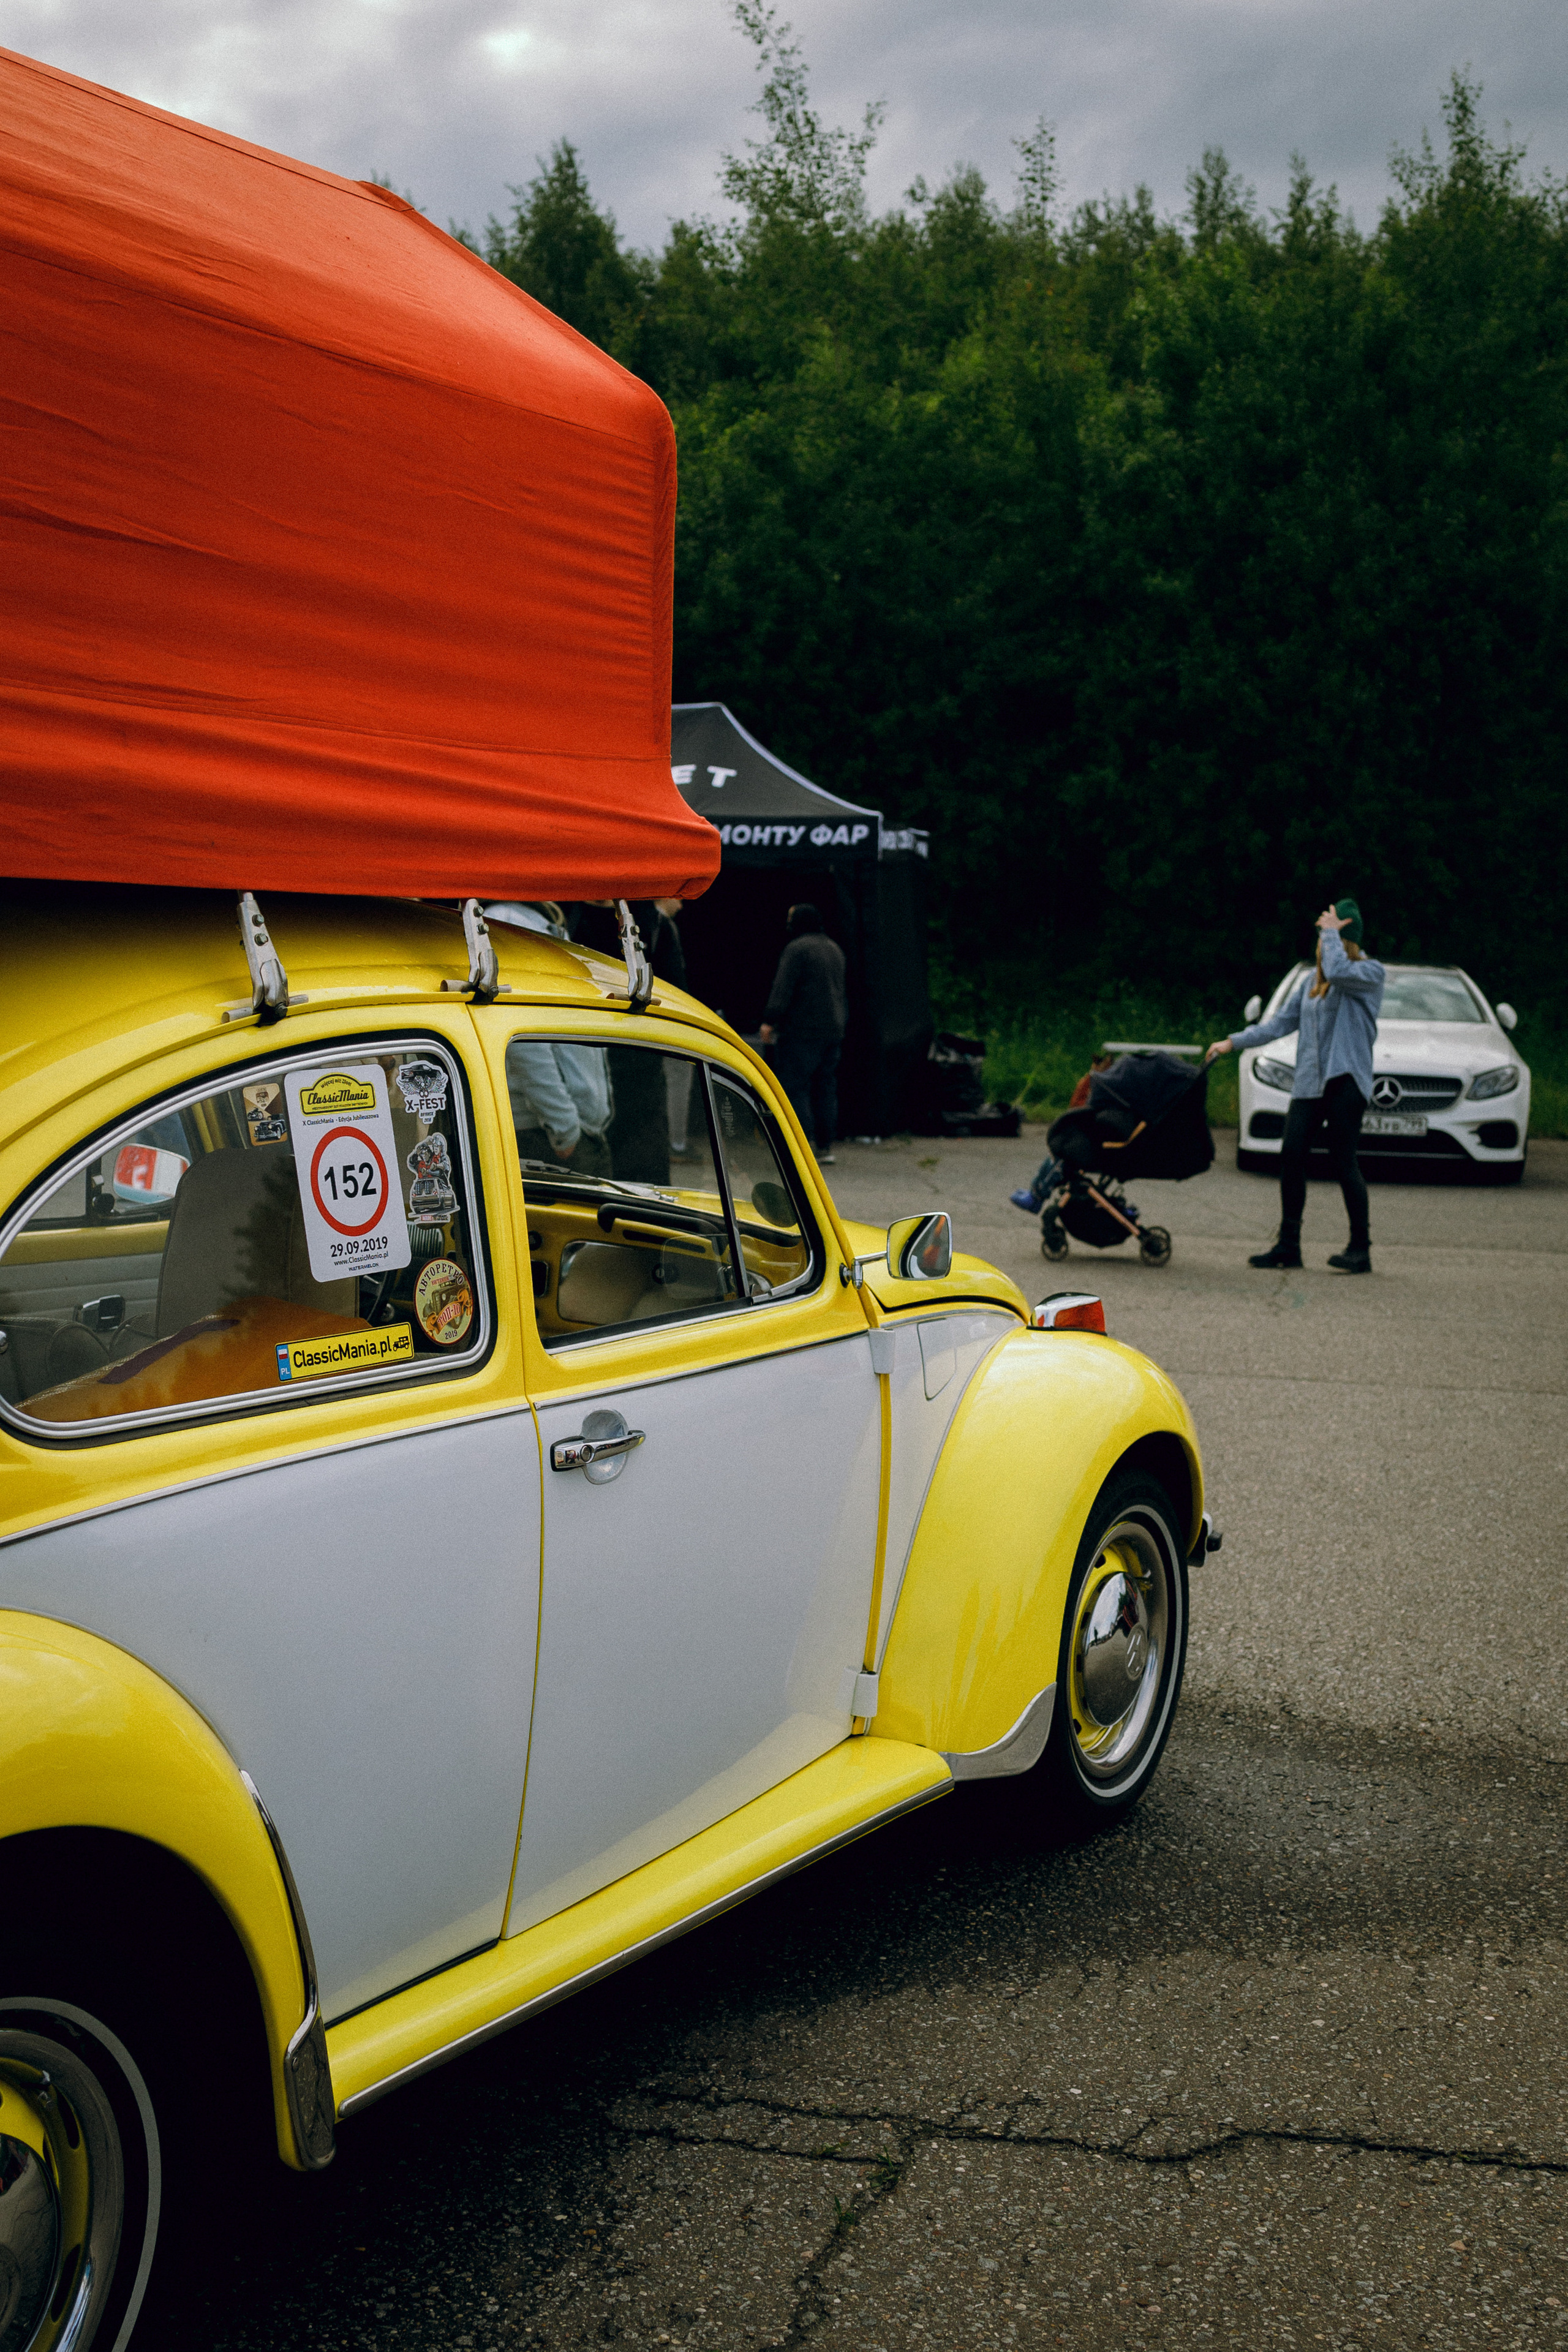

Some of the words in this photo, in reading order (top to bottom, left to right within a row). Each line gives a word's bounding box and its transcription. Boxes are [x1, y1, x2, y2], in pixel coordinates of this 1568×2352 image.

[810, 823, 869, 846] ФАР
[307, 1090, 369, 1105] ClassicMania
[406, 1097, 444, 1111] X-FEST
[307, 1117, 334, 1126] ClassicMania
[324, 1162, 377, 1200] 152
[330, 1230, 388, 1257] 29.09.2019
[334, 1251, 389, 1266] www.ClassicMania.pl
[349, 1262, 379, 1272] WATERMELON
[418, 1263, 464, 1297] АВТОРЕТРО
[437, 1302, 461, 1327] ТОП-10
[445, 1329, 458, 1340] 2019
[293, 1335, 392, 1368] ClassicMania.pl
[281, 1366, 290, 1375] PL
